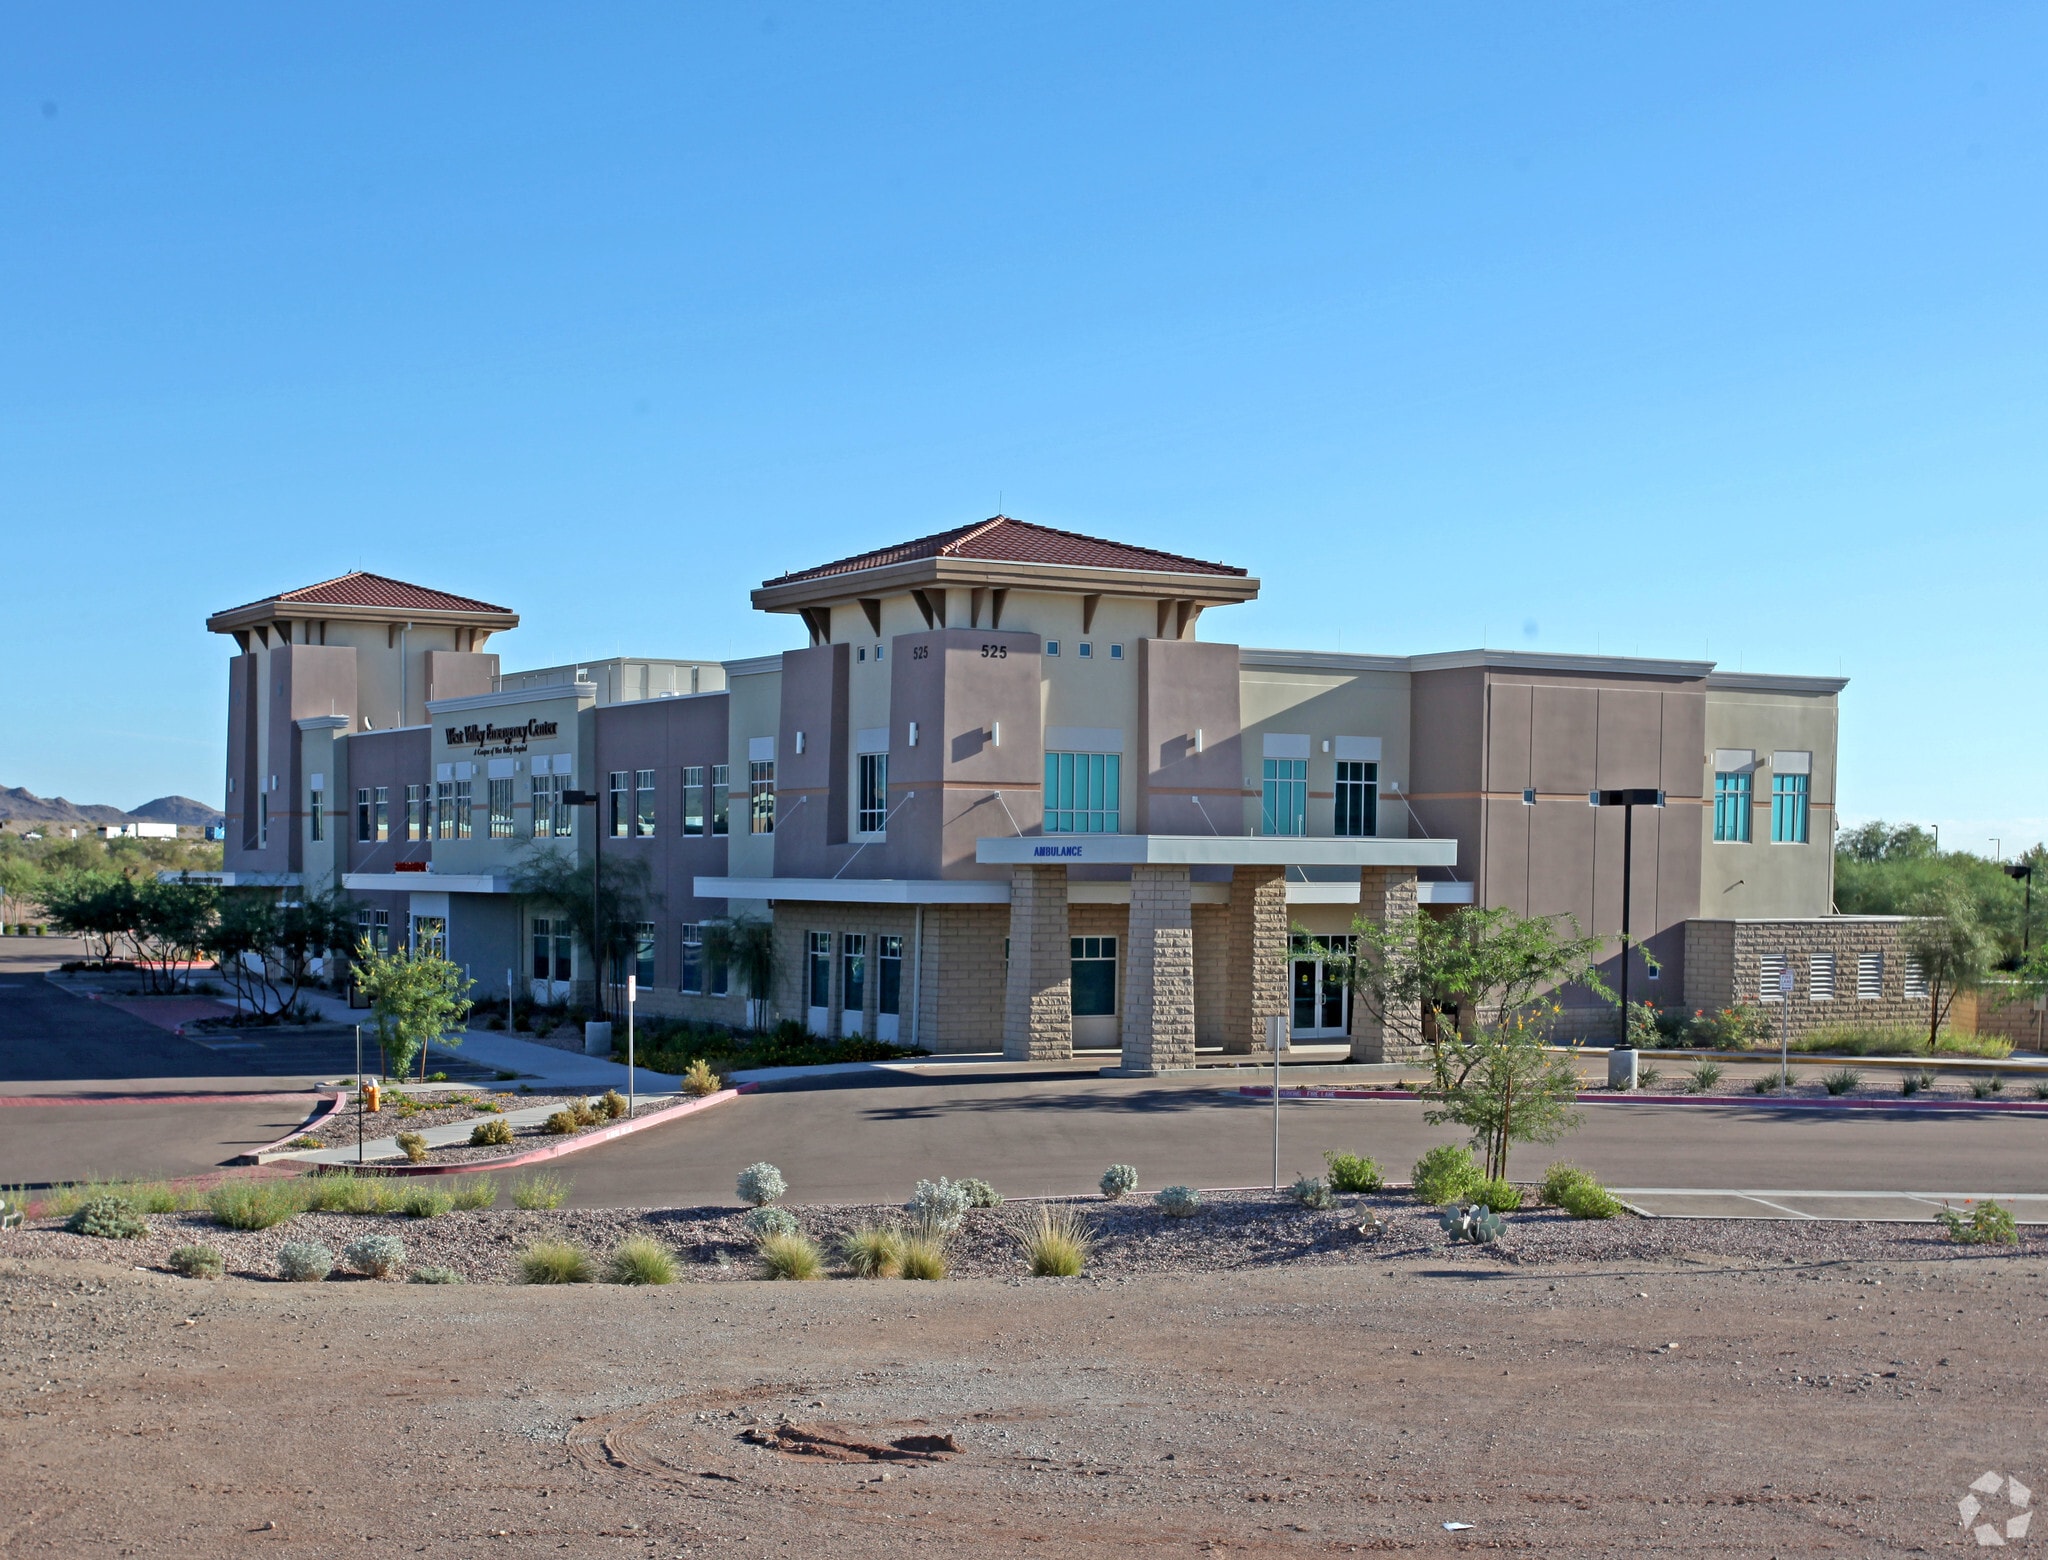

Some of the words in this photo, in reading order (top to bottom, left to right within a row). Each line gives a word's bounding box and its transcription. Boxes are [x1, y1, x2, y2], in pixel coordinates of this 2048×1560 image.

[913, 646, 929, 660] 525
[981, 645, 1007, 659] 525
[445, 727, 464, 745] West
[464, 724, 486, 748] Valley
[486, 723, 528, 745] Emergency
[528, 718, 558, 737] Center
[1033, 846, 1083, 857] AMBULANCE
